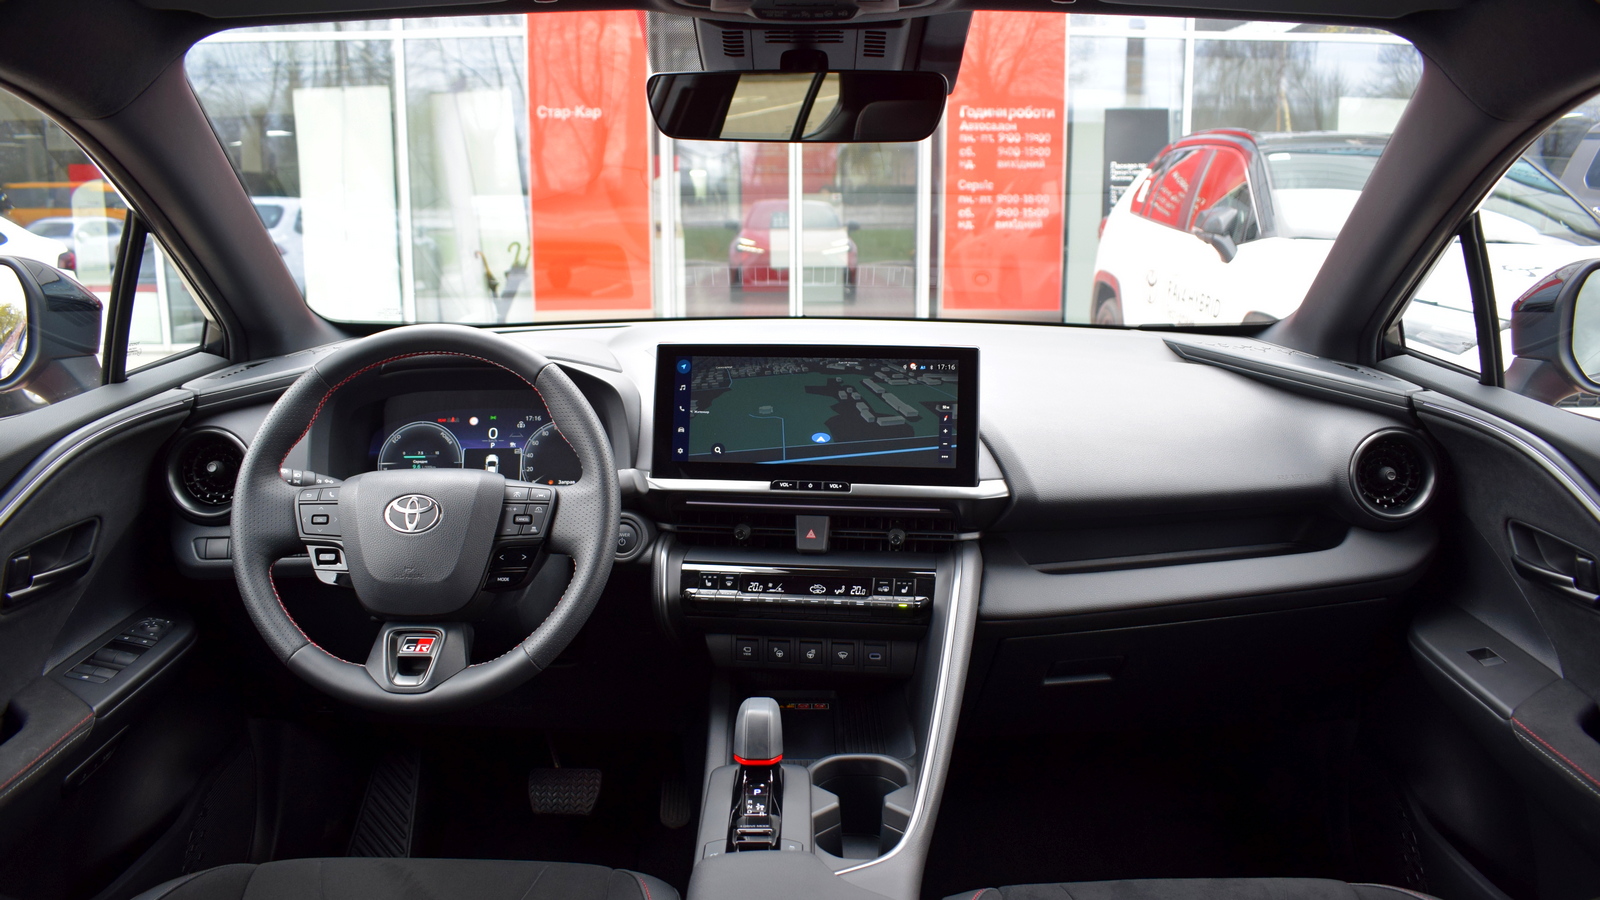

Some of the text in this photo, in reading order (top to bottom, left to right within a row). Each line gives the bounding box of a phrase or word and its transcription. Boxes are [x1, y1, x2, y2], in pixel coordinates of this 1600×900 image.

[536, 105, 602, 120] Стар-Кар
[959, 105, 1056, 121] Години роботи
[959, 121, 1017, 131] Автосалон
[440, 431, 454, 445] POWER
[488, 427, 499, 439] 0
[391, 434, 402, 444] ECO
[748, 582, 764, 592] 20.0
[850, 585, 866, 596] 20.0
[402, 643, 430, 652] GR
